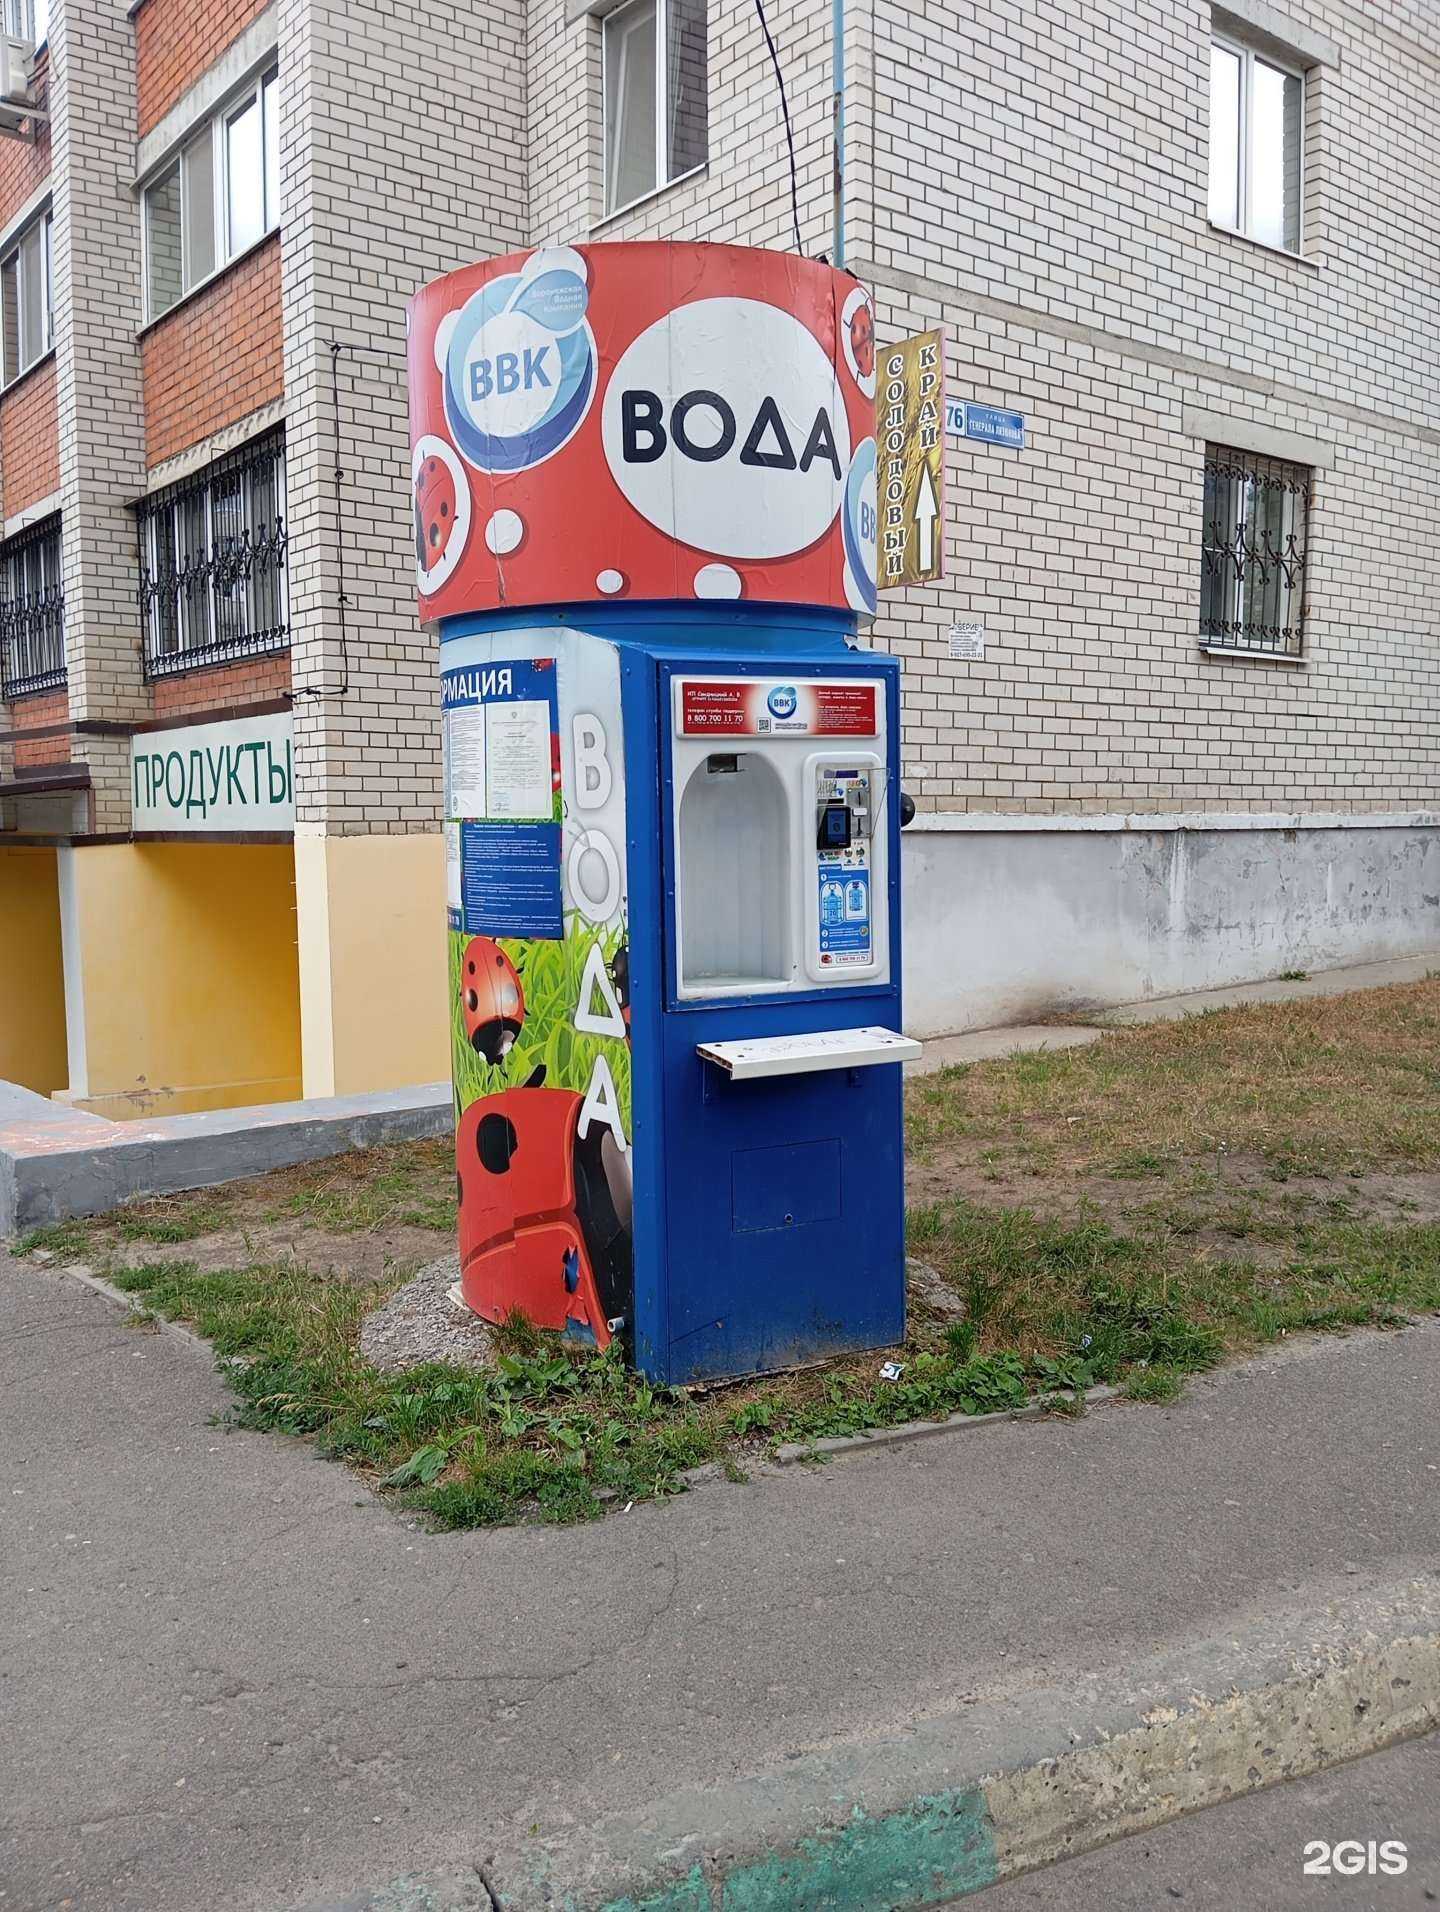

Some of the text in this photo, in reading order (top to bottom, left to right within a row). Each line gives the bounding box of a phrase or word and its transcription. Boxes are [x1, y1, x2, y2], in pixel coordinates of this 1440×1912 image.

[469, 348, 552, 402] ВВК
[919, 344, 938, 450] КРАЙ
[946, 406, 963, 429] 76
[621, 389, 842, 481] ВОДА
[884, 354, 905, 577] СОЛОДОВЫЙ
[134, 739, 292, 819] ПРОДУКТЫ
[568, 713, 627, 1152] ВОДА
